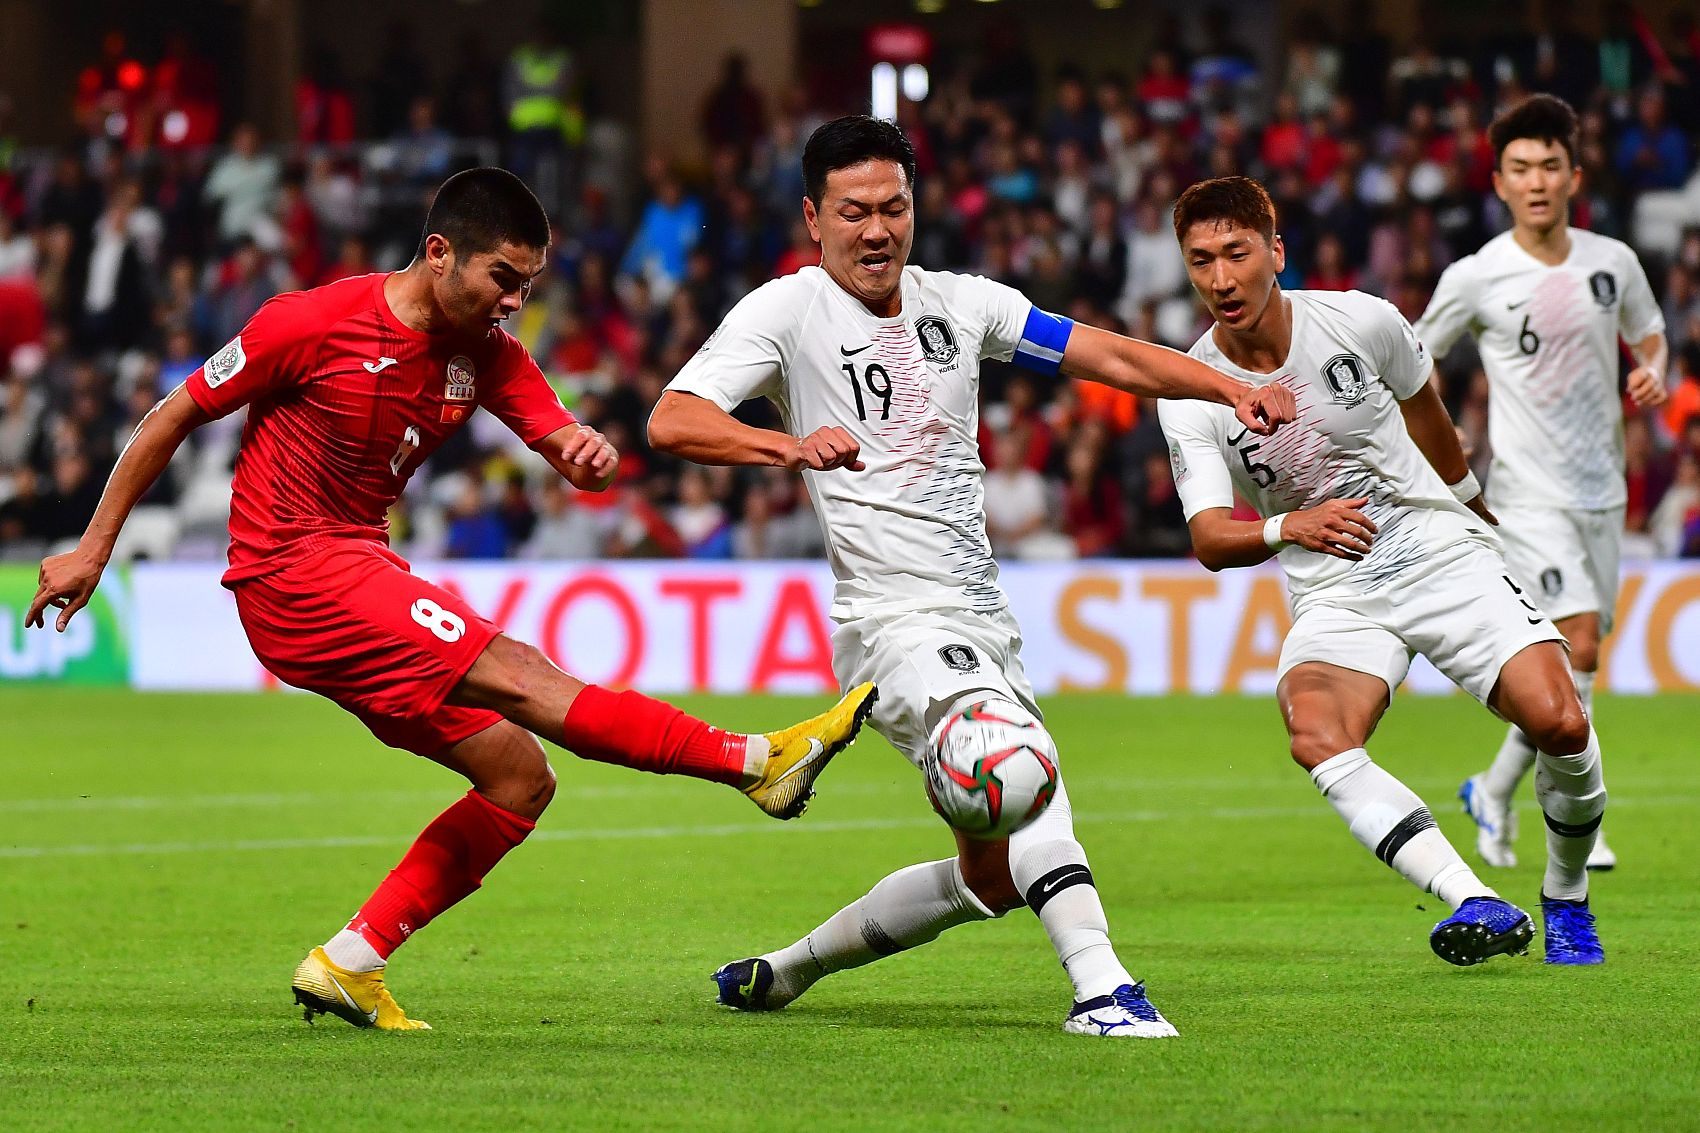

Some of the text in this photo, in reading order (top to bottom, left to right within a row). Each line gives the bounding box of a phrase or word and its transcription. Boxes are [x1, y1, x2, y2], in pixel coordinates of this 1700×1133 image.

[1520, 314, 1539, 355] 6
[842, 363, 892, 421] 19
[390, 425, 420, 476] 8
[1239, 443, 1276, 488] 5
[262, 577, 840, 692] YOTA
[410, 598, 466, 643] 8
